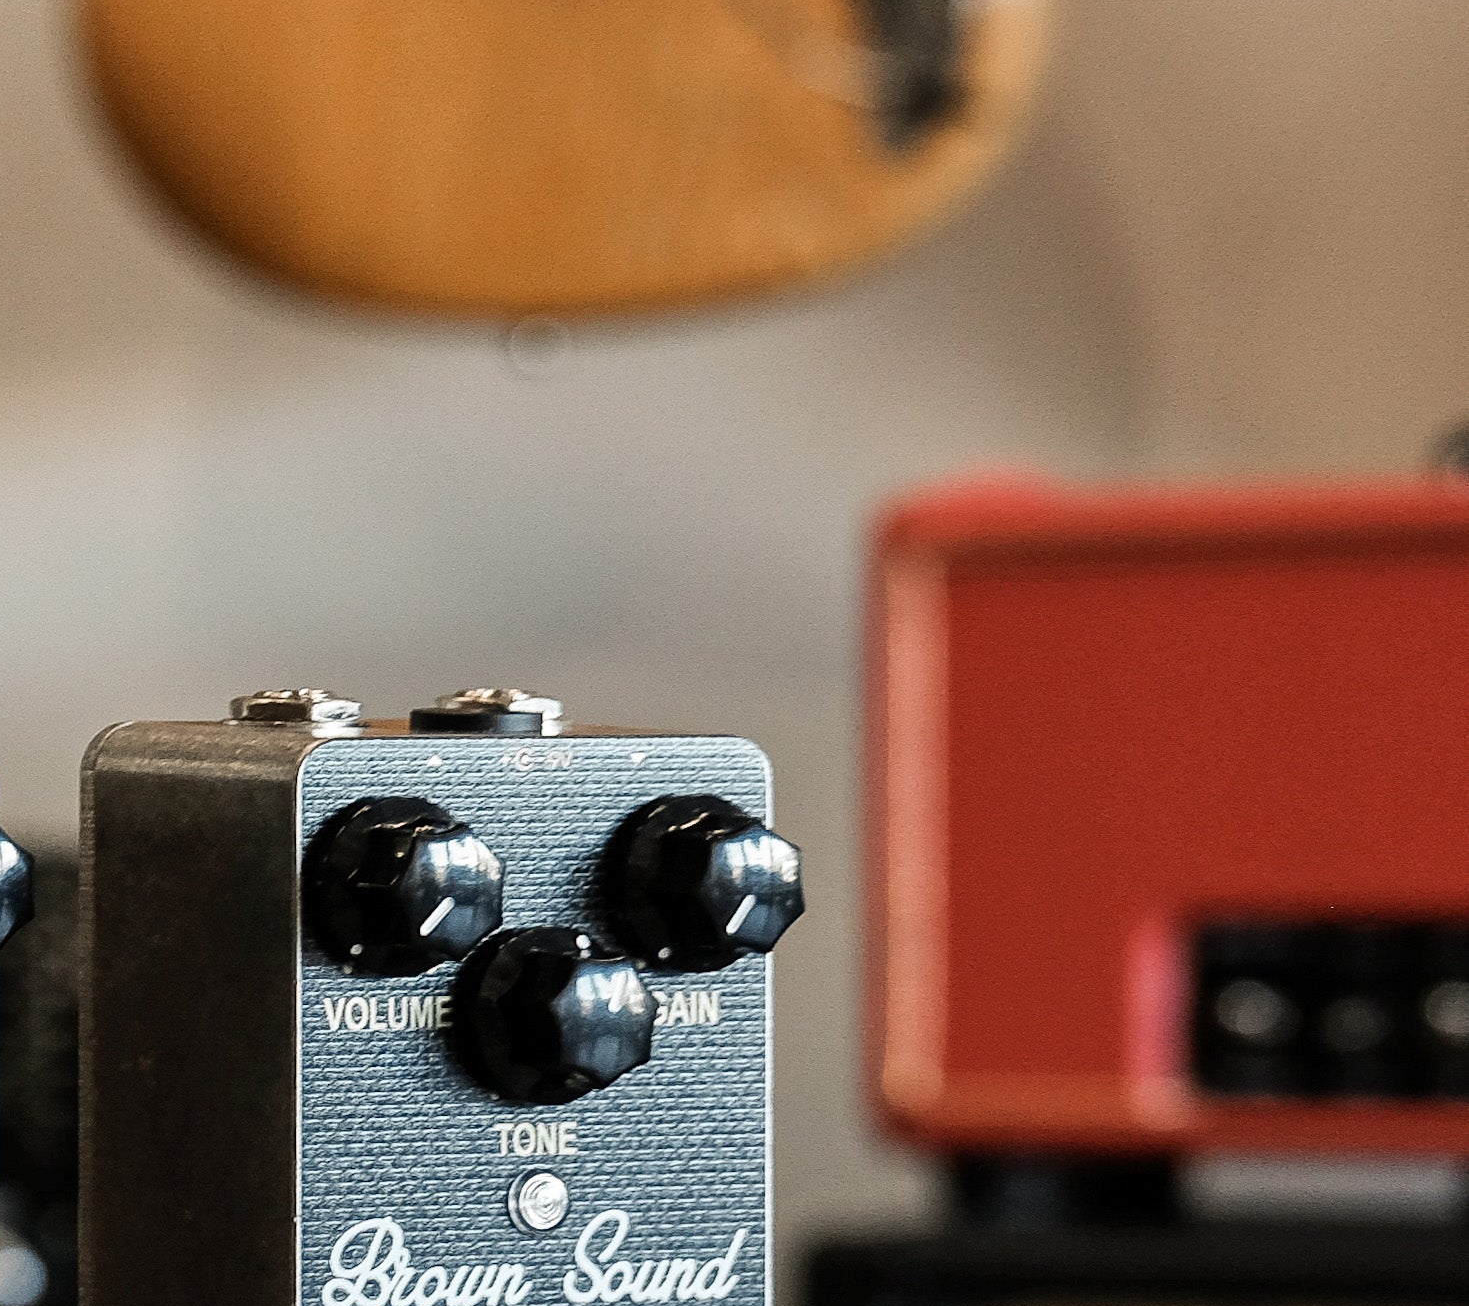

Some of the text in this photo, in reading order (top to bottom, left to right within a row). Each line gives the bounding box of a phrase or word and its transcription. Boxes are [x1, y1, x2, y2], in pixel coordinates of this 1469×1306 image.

[323, 996, 454, 1030] VOLUME
[495, 1123, 579, 1157] TONE
[563, 1209, 748, 1304] Sound
